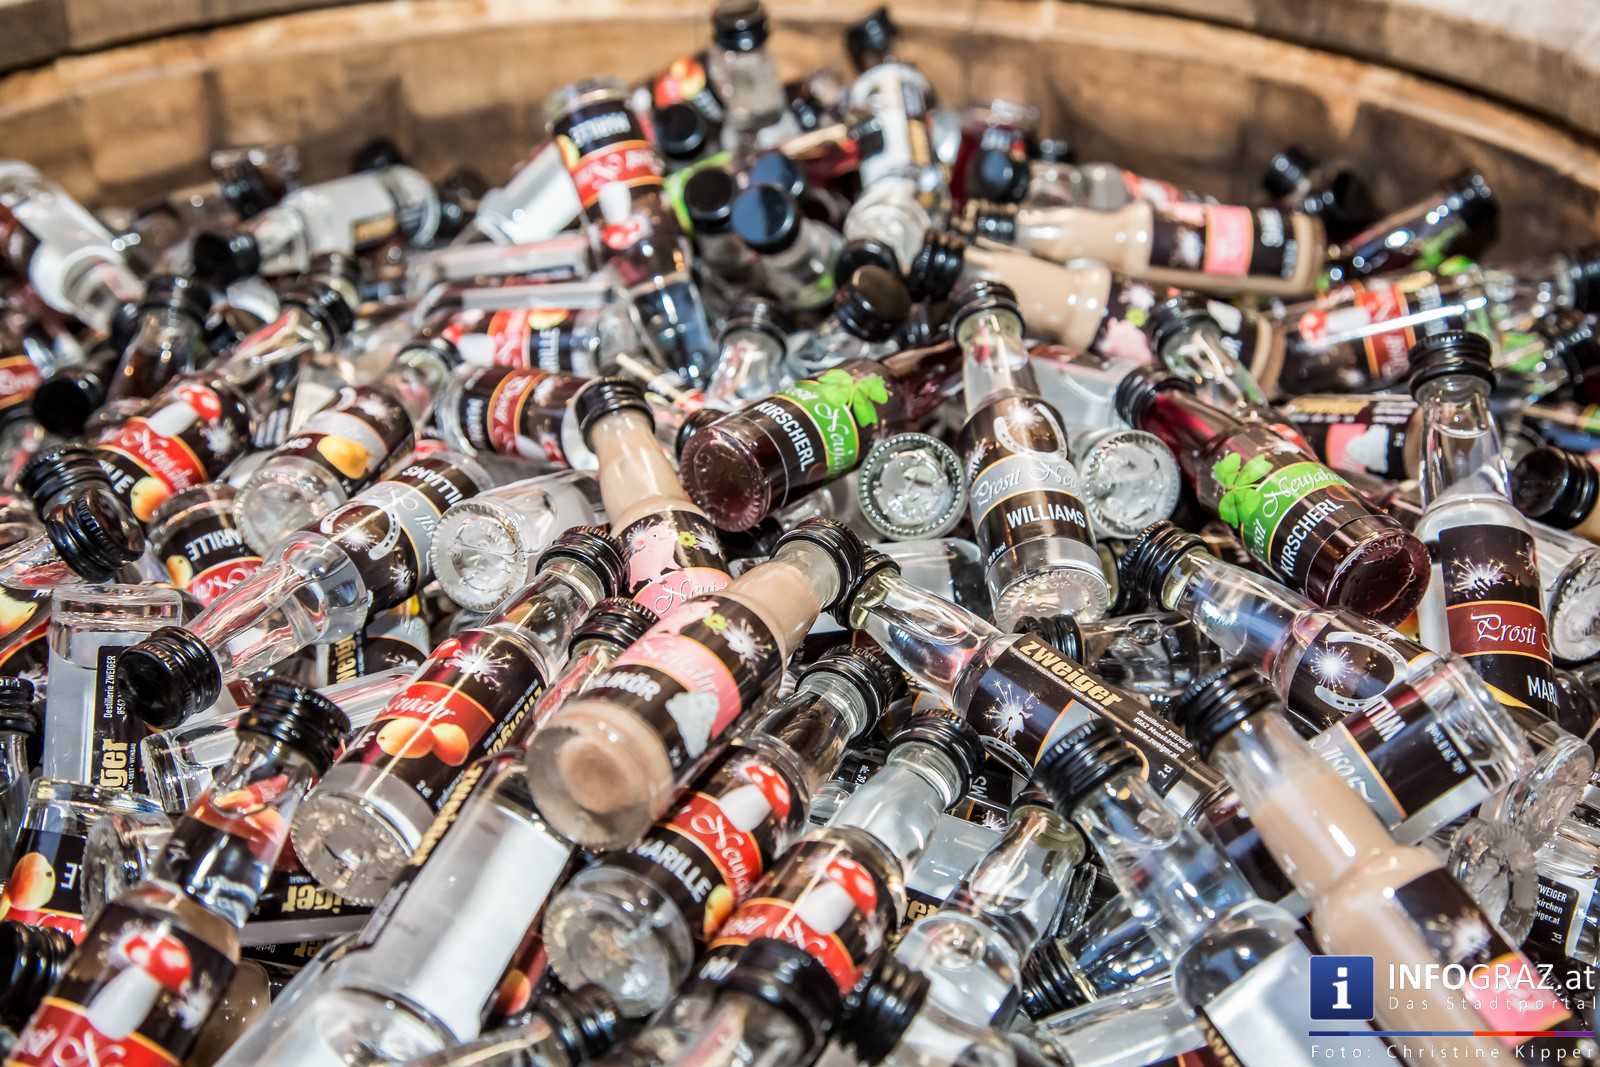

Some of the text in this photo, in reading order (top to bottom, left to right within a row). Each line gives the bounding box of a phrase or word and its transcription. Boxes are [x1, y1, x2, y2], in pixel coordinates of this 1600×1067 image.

[753, 401, 816, 472] KIRSCHERL
[1006, 504, 1086, 528] WILLIAMS
[1280, 499, 1345, 577] KIRSCHERL
[1470, 613, 1537, 645] Prosit
[1020, 640, 1123, 707] zweiger
